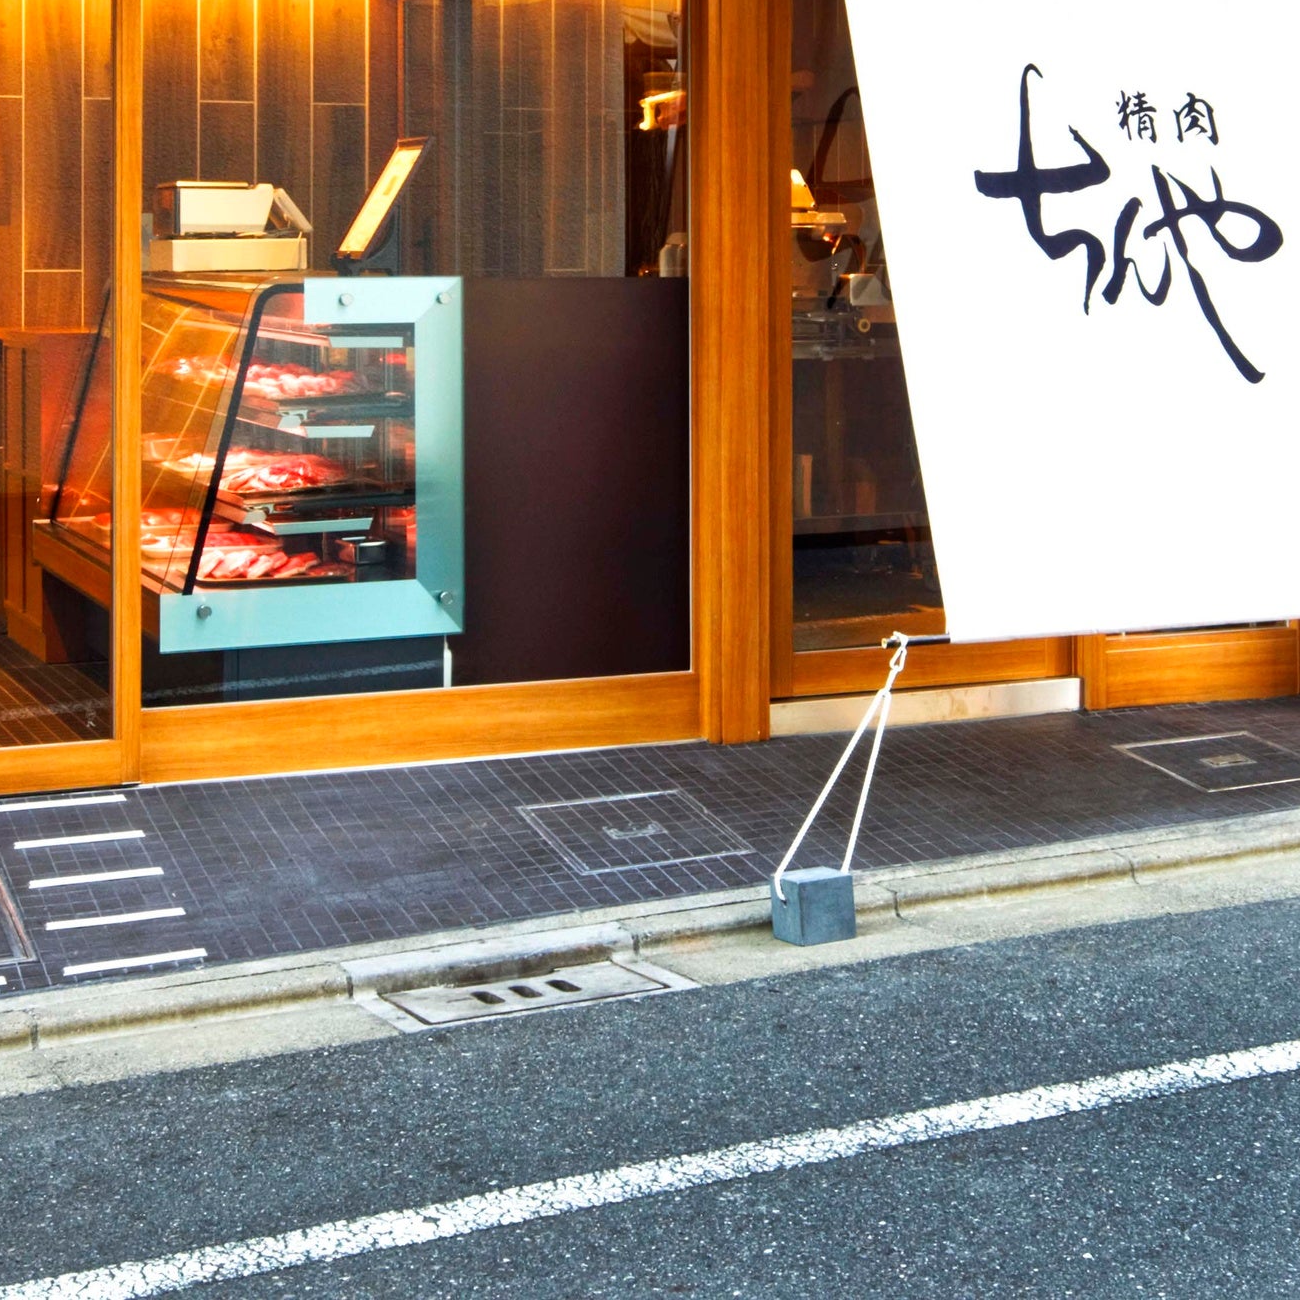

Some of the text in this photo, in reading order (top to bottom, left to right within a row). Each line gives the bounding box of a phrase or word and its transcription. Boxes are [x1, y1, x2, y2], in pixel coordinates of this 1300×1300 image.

[1115, 89, 1220, 146] 精肉
[973, 62, 1285, 385] ちんや
